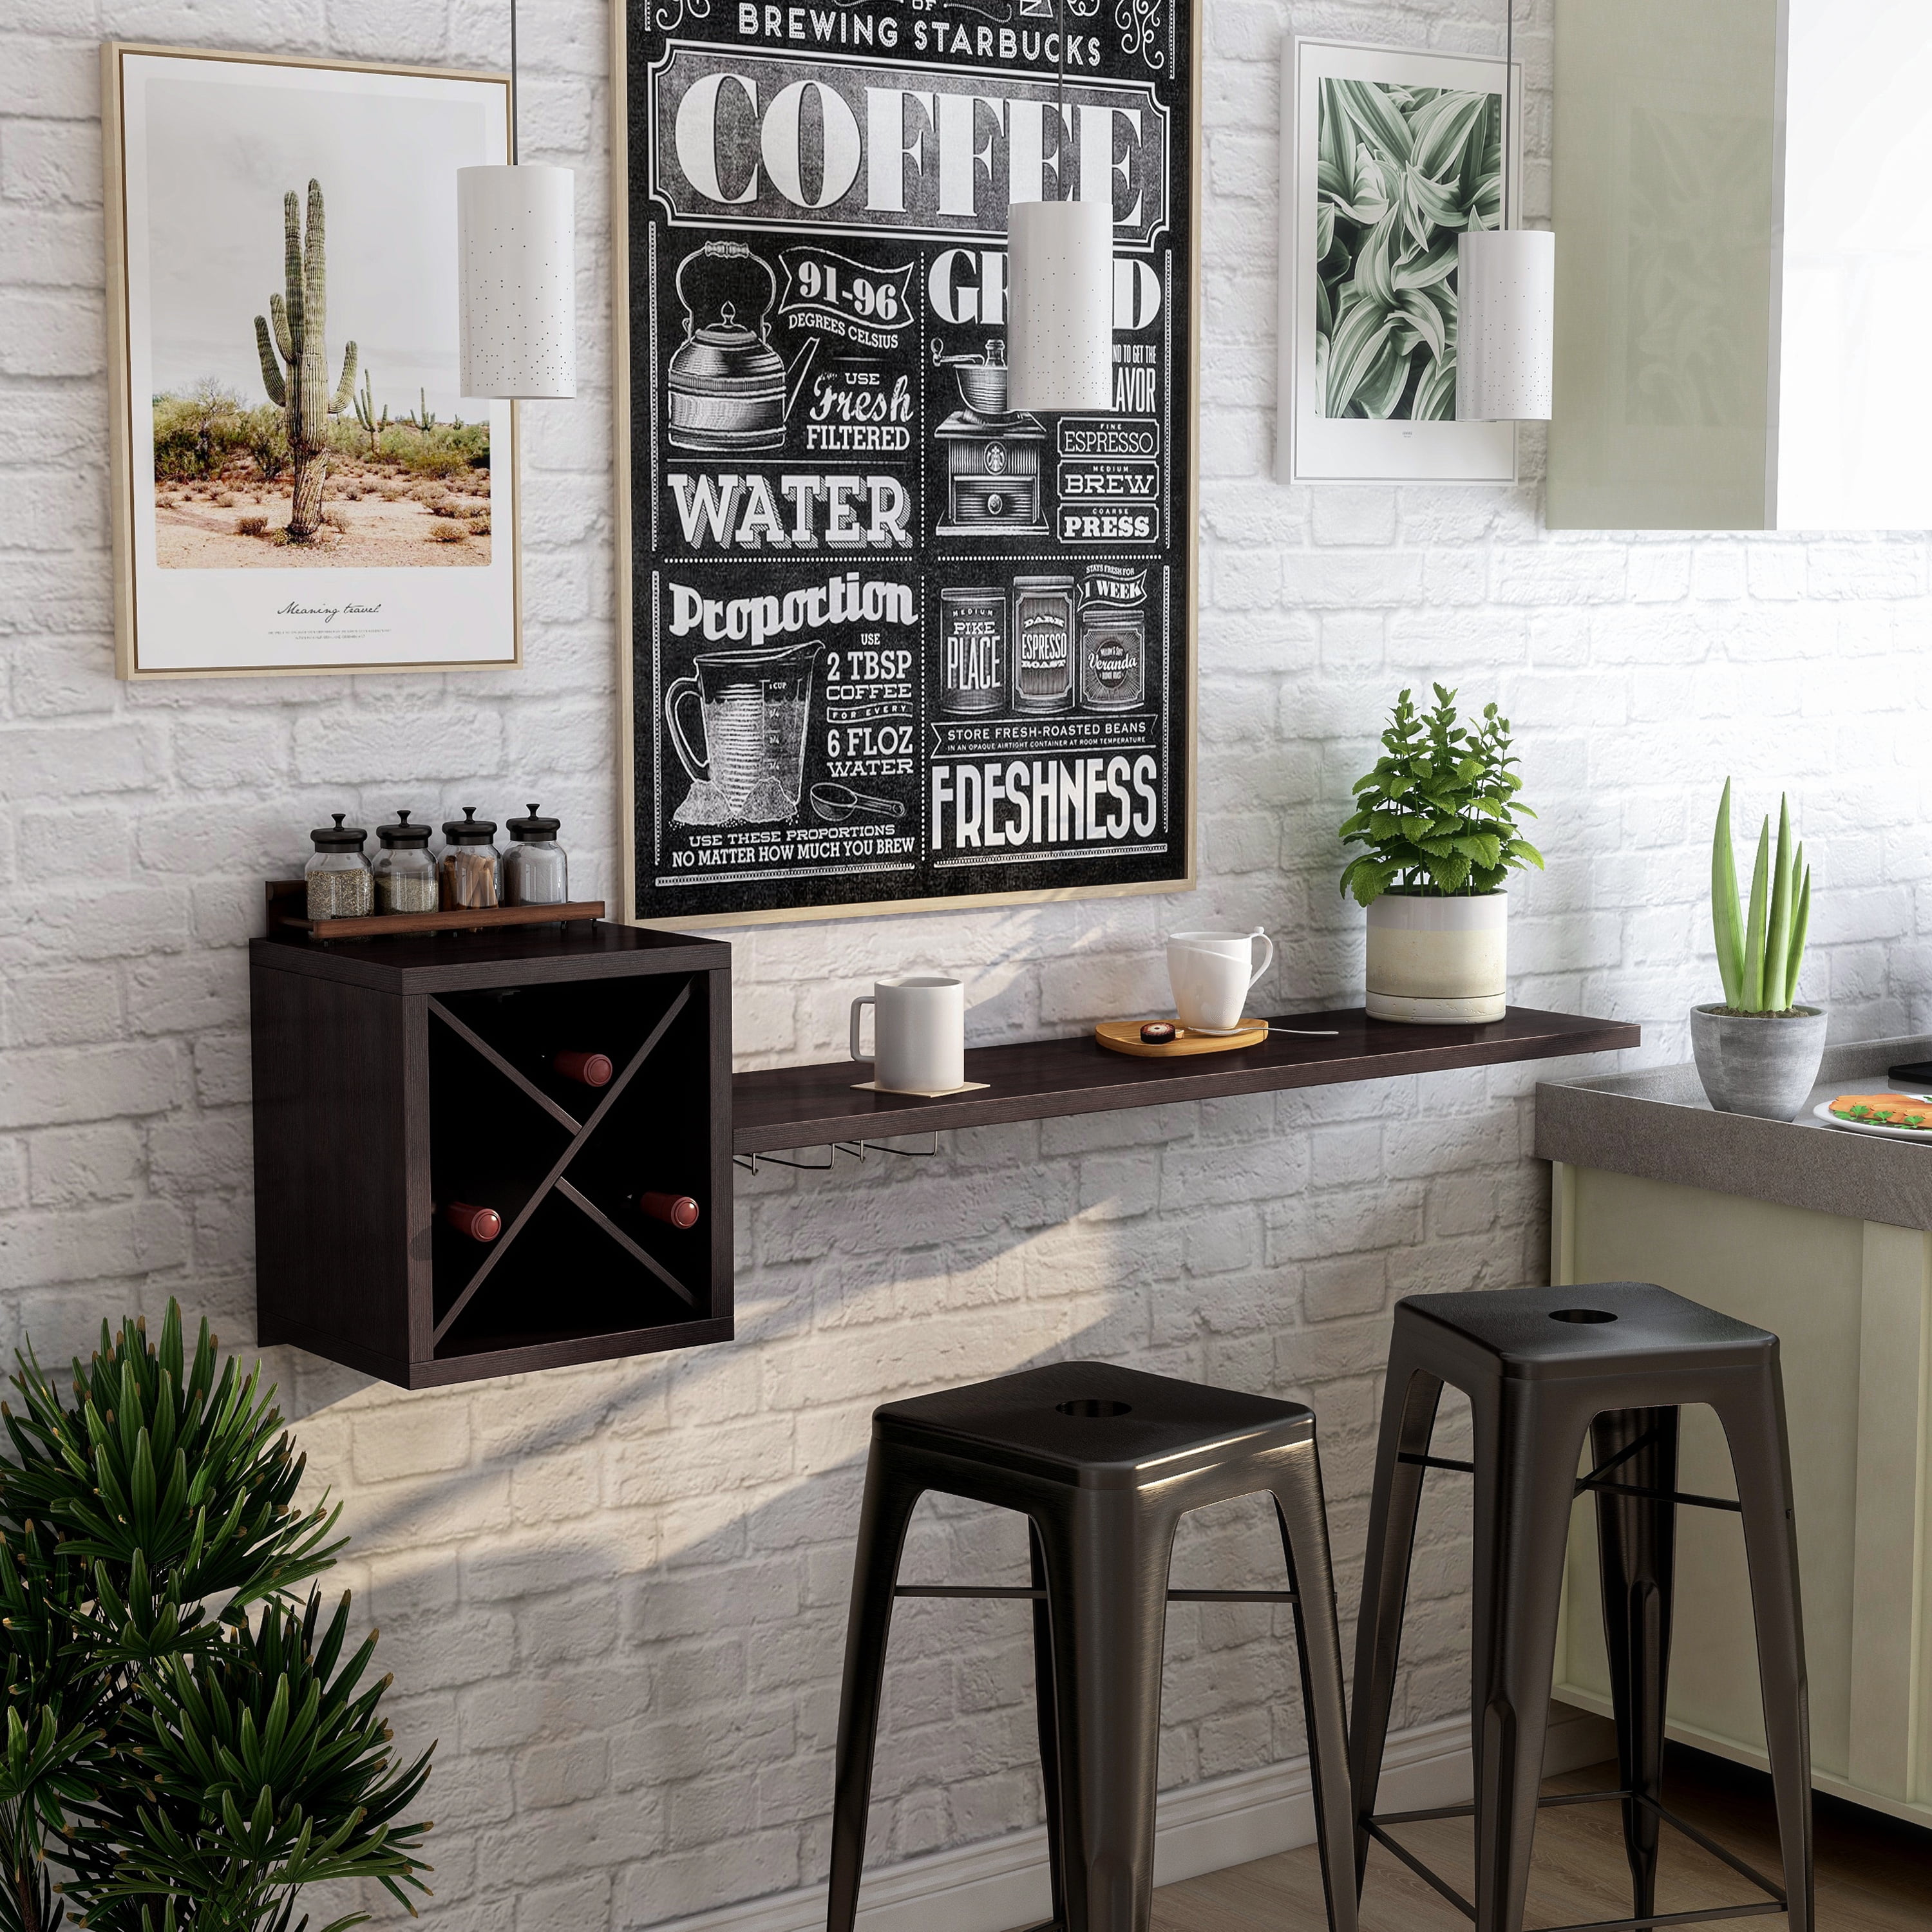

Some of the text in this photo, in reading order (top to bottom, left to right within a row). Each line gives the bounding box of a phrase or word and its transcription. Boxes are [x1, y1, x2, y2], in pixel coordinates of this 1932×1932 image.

[739, 2, 1101, 66] BREWING STARBUCKS
[675, 72, 1143, 227] COFFEE
[798, 261, 897, 321] 91-96
[927, 248, 1161, 330] GRD
[788, 312, 898, 349] DEGREES CELSIUS
[1123, 345, 1131, 363] TO
[1133, 345, 1144, 363] GET
[1145, 345, 1156, 364] THE
[844, 373, 880, 385] USE
[809, 374, 914, 422] Fresh
[806, 424, 911, 450] FILTERED
[1064, 430, 1153, 453] ESPRESSO
[1065, 473, 1154, 494] BREW
[667, 473, 913, 550] WATER
[1064, 515, 1150, 537] PRESS
[1086, 564, 1135, 576] STAYS FRESH FOR
[1096, 579, 1142, 599] WEEK
[277, 601, 382, 623] Meaning travel
[668, 572, 919, 646] Proportion
[952, 608, 994, 617] MEDIUM
[953, 621, 996, 635] PIKE
[1024, 615, 1065, 629] DARK
[861, 633, 881, 645] USE
[1021, 632, 1067, 661] ESPRESSO
[827, 650, 913, 681] 2 TBSP
[947, 635, 1001, 690] PLACE
[1021, 659, 1066, 669] ROAST
[1088, 652, 1138, 671] Veranda
[773, 681, 787, 690] CUP
[826, 683, 912, 701] COFFEE
[832, 705, 907, 720] FOR EVERY
[947, 721, 1146, 741] STORE FRESH-ROASTED BEANS
[827, 728, 840, 758] 6
[968, 742, 995, 751] OPAQUE
[1030, 739, 1067, 748] CONTAINER
[1099, 736, 1146, 745] TEMPERATURE
[826, 758, 914, 778] WATER
[931, 755, 1157, 850] FRESHNESS
[689, 824, 896, 848] USE THESE PROPORTIONS
[672, 837, 915, 867] NO MATTER HOW MUCH YOU BREW
